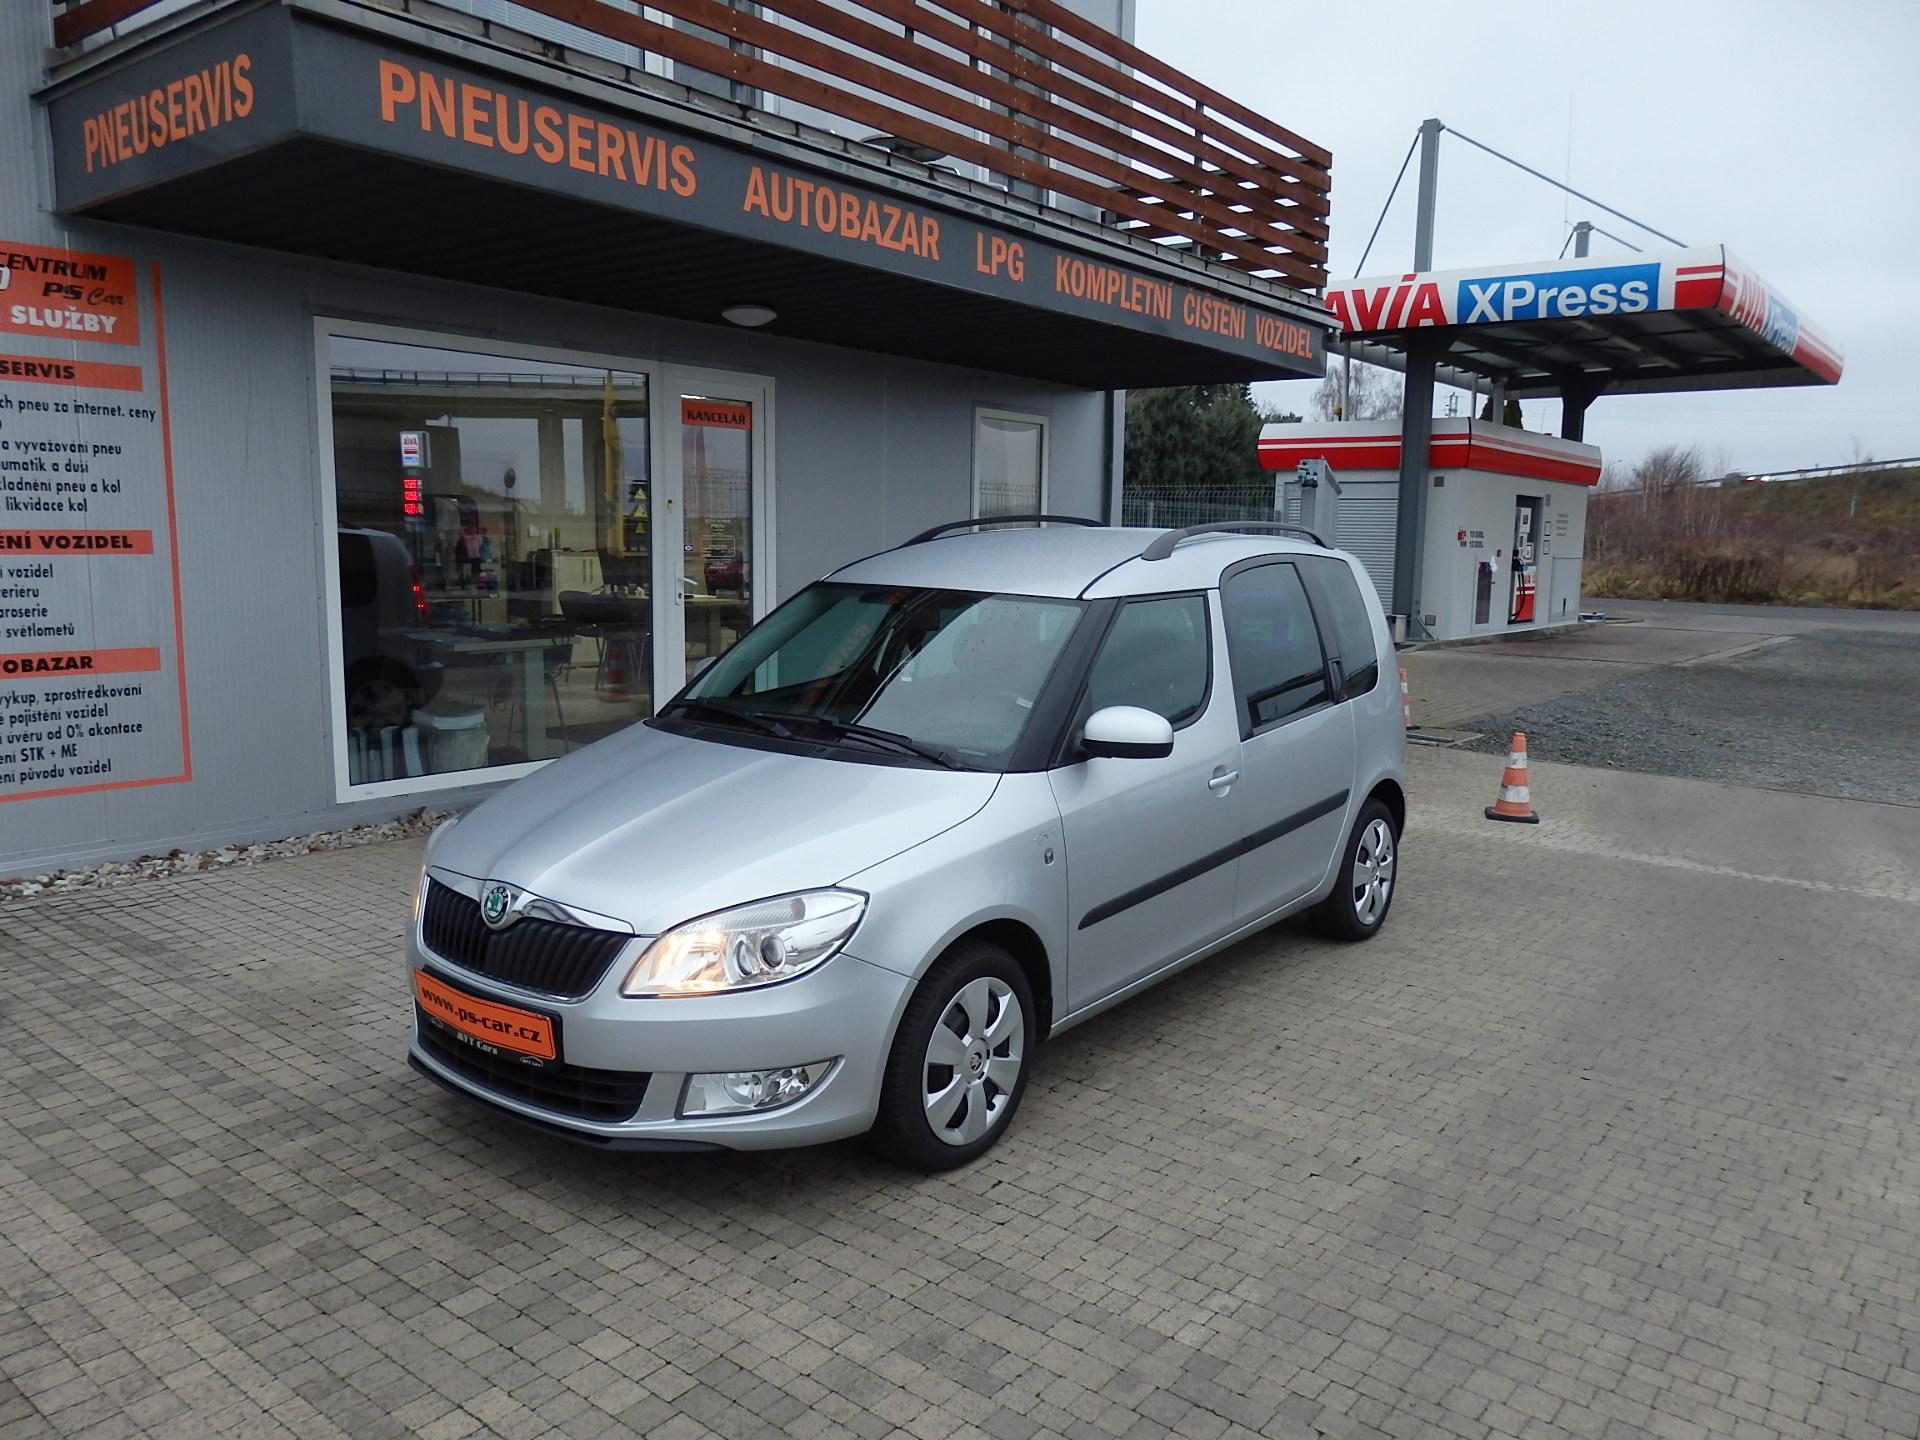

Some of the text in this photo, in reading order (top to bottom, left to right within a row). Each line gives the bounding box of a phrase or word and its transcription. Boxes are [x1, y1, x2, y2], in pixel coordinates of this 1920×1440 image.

[83, 53, 254, 173] PNEUSERVIS
[378, 59, 697, 197] PNEUSERVIS
[743, 167, 940, 261] AUTOBAZAR
[976, 232, 1025, 283] LPG
[1055, 254, 1173, 320] KOMPLETNÍ
[1256, 314, 1312, 358] VOZIDEL
[42, 282, 124, 305] PS Car
[1467, 279, 1650, 324] XPress
[11, 305, 117, 334] SLUŽBY
[18, 400, 49, 413] pneu
[54, 402, 68, 412] za
[74, 399, 125, 417] internet.
[129, 408, 156, 422] ceny
[15, 440, 88, 455] vyvažování
[93, 444, 121, 457] pneu
[52, 462, 59, 472] a
[0, 475, 121, 495] ladnění pneu a kol
[6, 496, 87, 512] likvidace kol
[38, 535, 133, 549] VOZIDEL
[8, 563, 53, 578] vozidel
[6, 622, 74, 638] světlometů
[0, 656, 93, 673] OBAZAR
[44, 682, 142, 705] zprostředkování
[9, 708, 61, 728] pojištění
[66, 703, 108, 720] vozidel
[47, 726, 62, 740] od
[66, 724, 84, 738] 0%
[89, 722, 143, 737] akontace
[20, 747, 45, 762] STK
[61, 743, 78, 758] ME
[20, 765, 64, 784] původu
[69, 758, 111, 775] vozidel
[422, 987, 542, 1043] www.ps-car.cz
